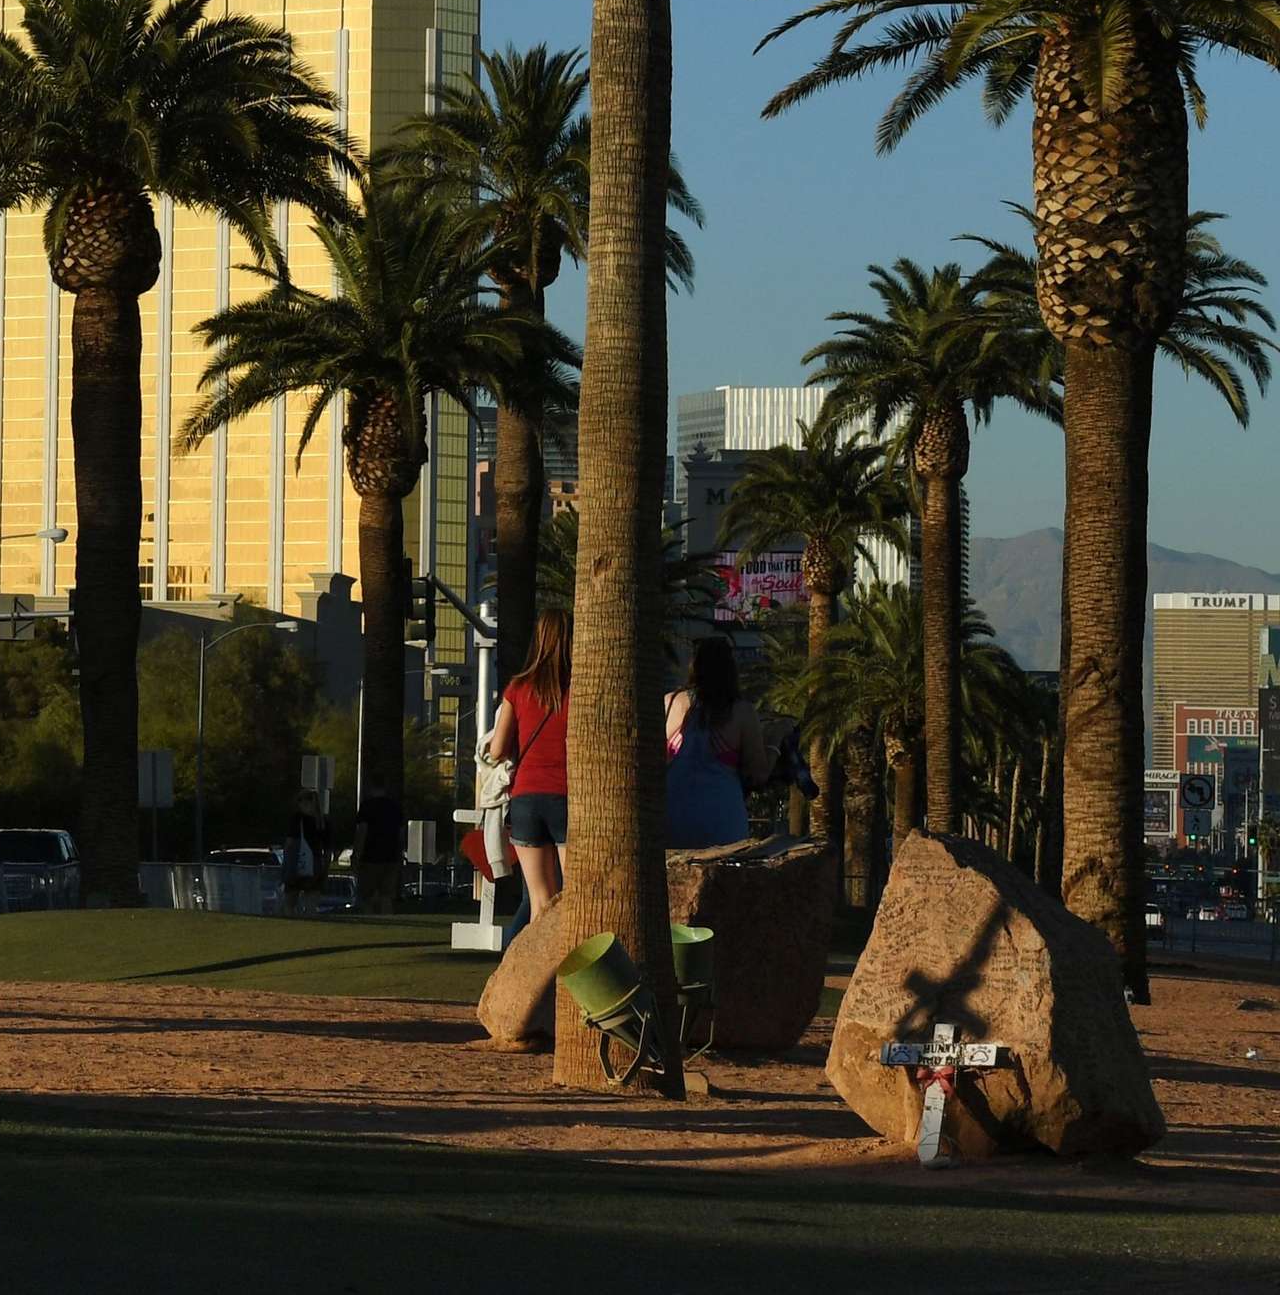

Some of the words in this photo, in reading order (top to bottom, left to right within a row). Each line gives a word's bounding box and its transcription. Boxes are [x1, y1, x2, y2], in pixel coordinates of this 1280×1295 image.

[785, 559, 802, 572] FEE
[1191, 597, 1247, 608] TRUMP
[1216, 709, 1257, 719] TREAS
